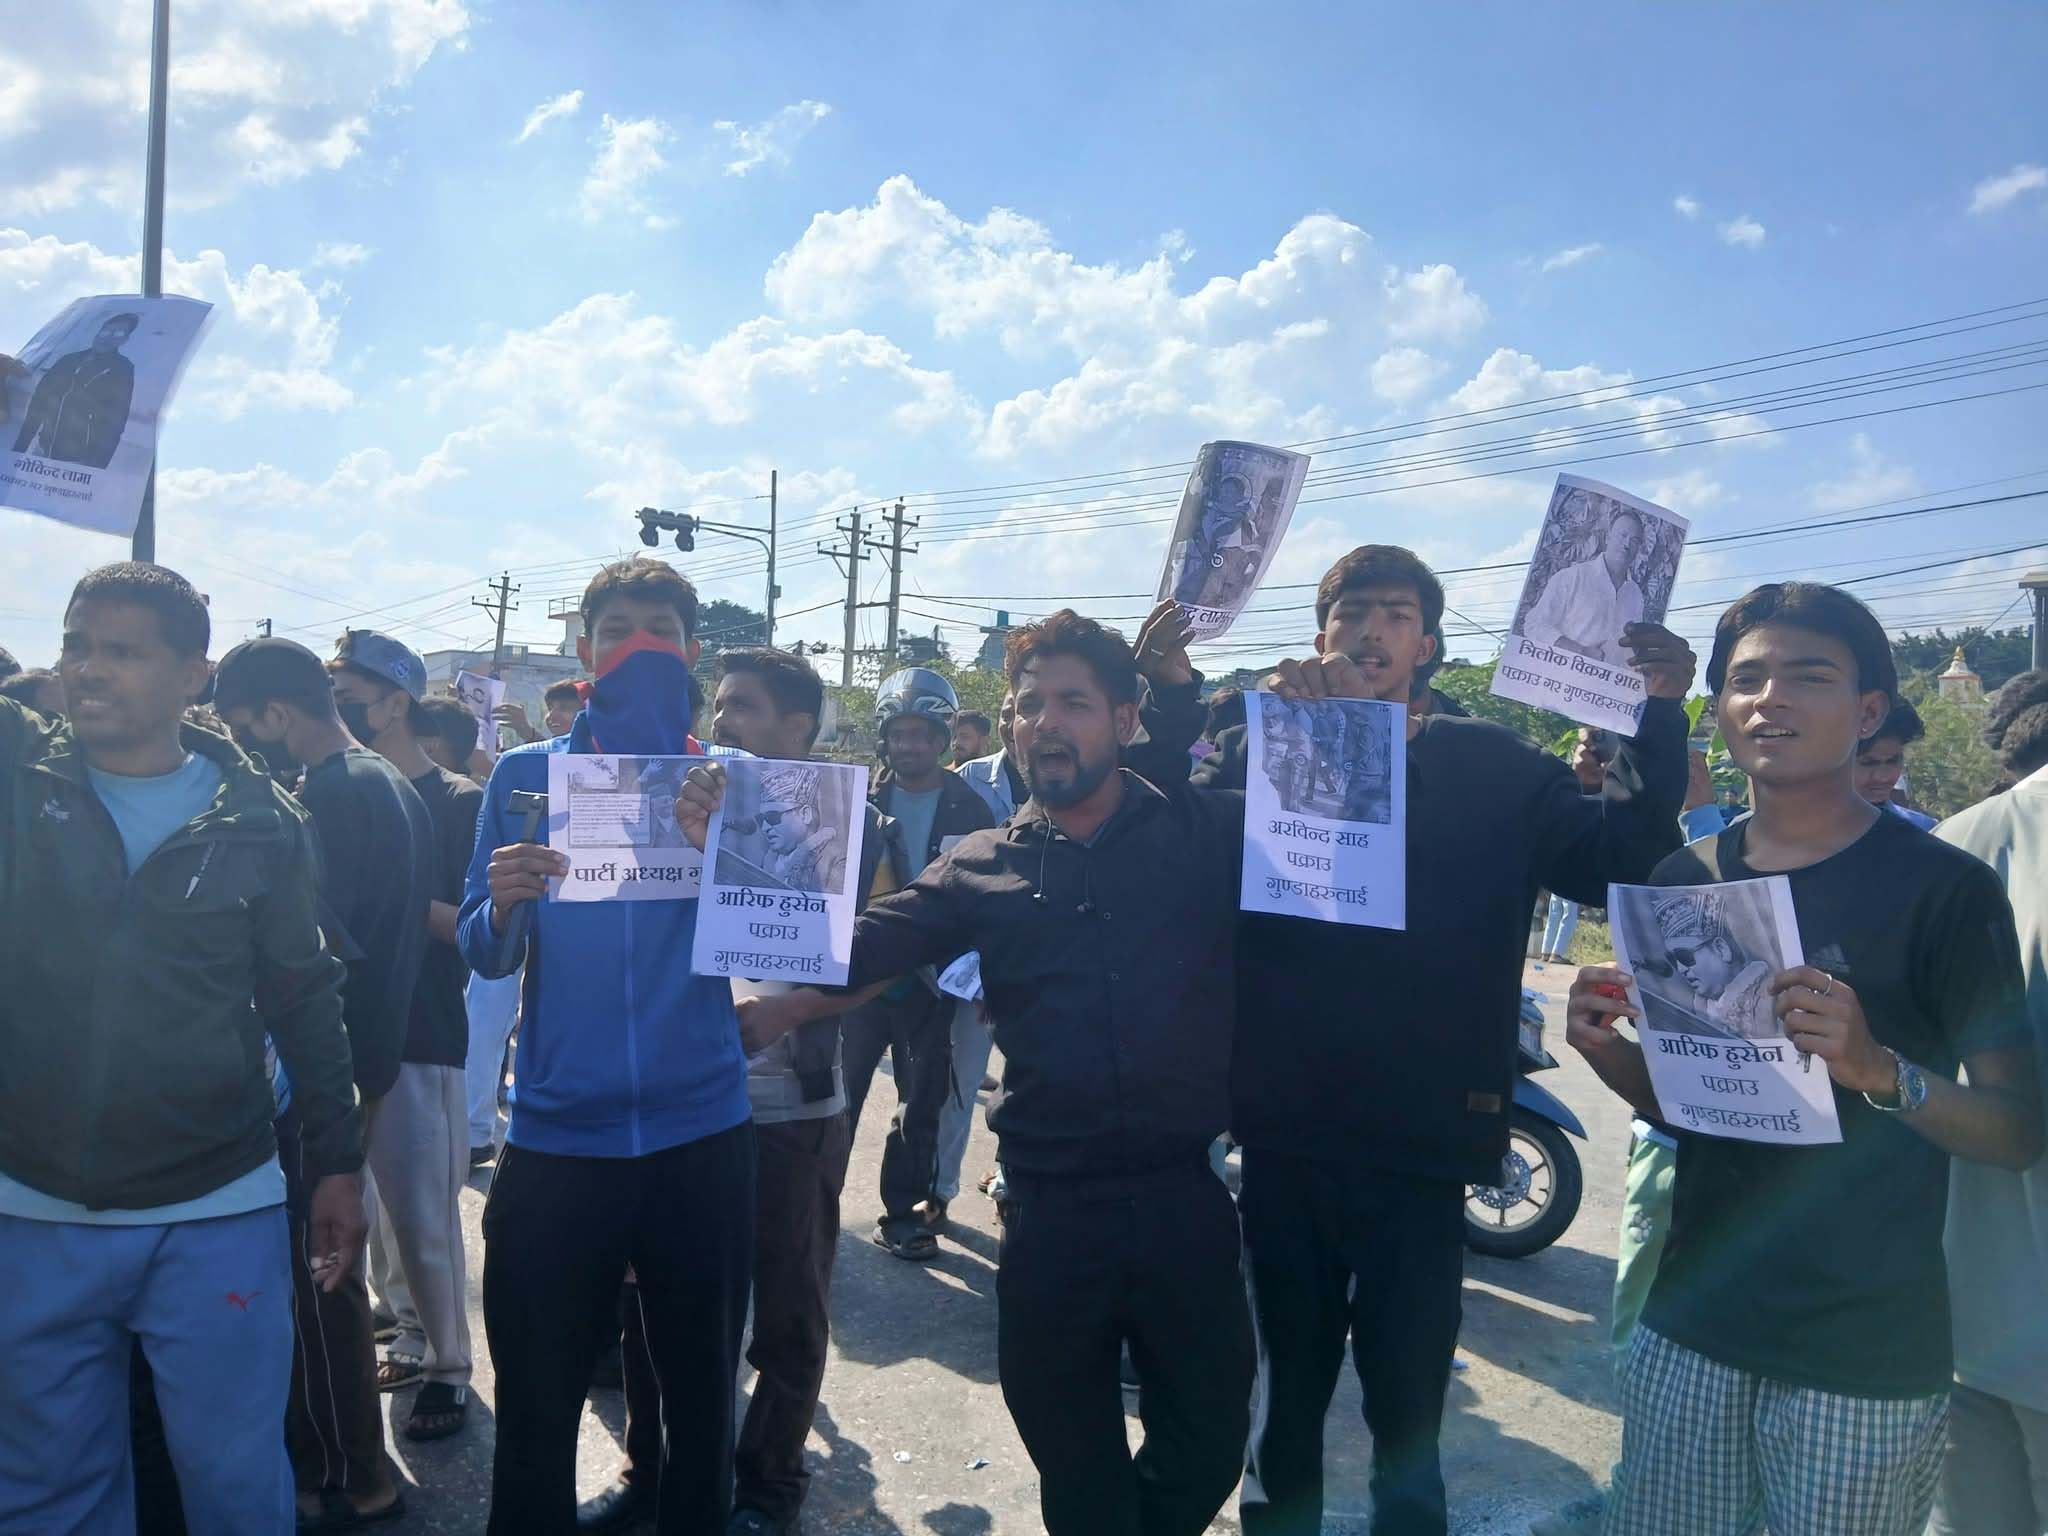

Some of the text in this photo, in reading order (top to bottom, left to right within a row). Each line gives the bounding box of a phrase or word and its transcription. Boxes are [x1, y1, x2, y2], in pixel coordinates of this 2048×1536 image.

[1502, 665, 1542, 686] पक्राउ
[1543, 676, 1562, 693] गर
[1518, 639, 1569, 666] त्रिलोक
[1614, 671, 1642, 692] शाह
[1268, 820, 1370, 848] अरविन्द साह
[574, 862, 617, 882] पार्टी
[621, 866, 682, 883] अध्यक्ष
[1287, 850, 1332, 871] पक्राउ
[716, 887, 828, 917] आरिफ हुसेन
[1266, 876, 1369, 906] गुण्डाहरुलाई
[749, 922, 801, 940] पक्राउ
[714, 950, 825, 975] गुण्डाहरुलाई
[1658, 1034, 1784, 1070] आरिफ हुसेन
[1700, 1074, 1760, 1096] पक्राउ
[1679, 1102, 1802, 1133] गुण्डाहरुलाई
